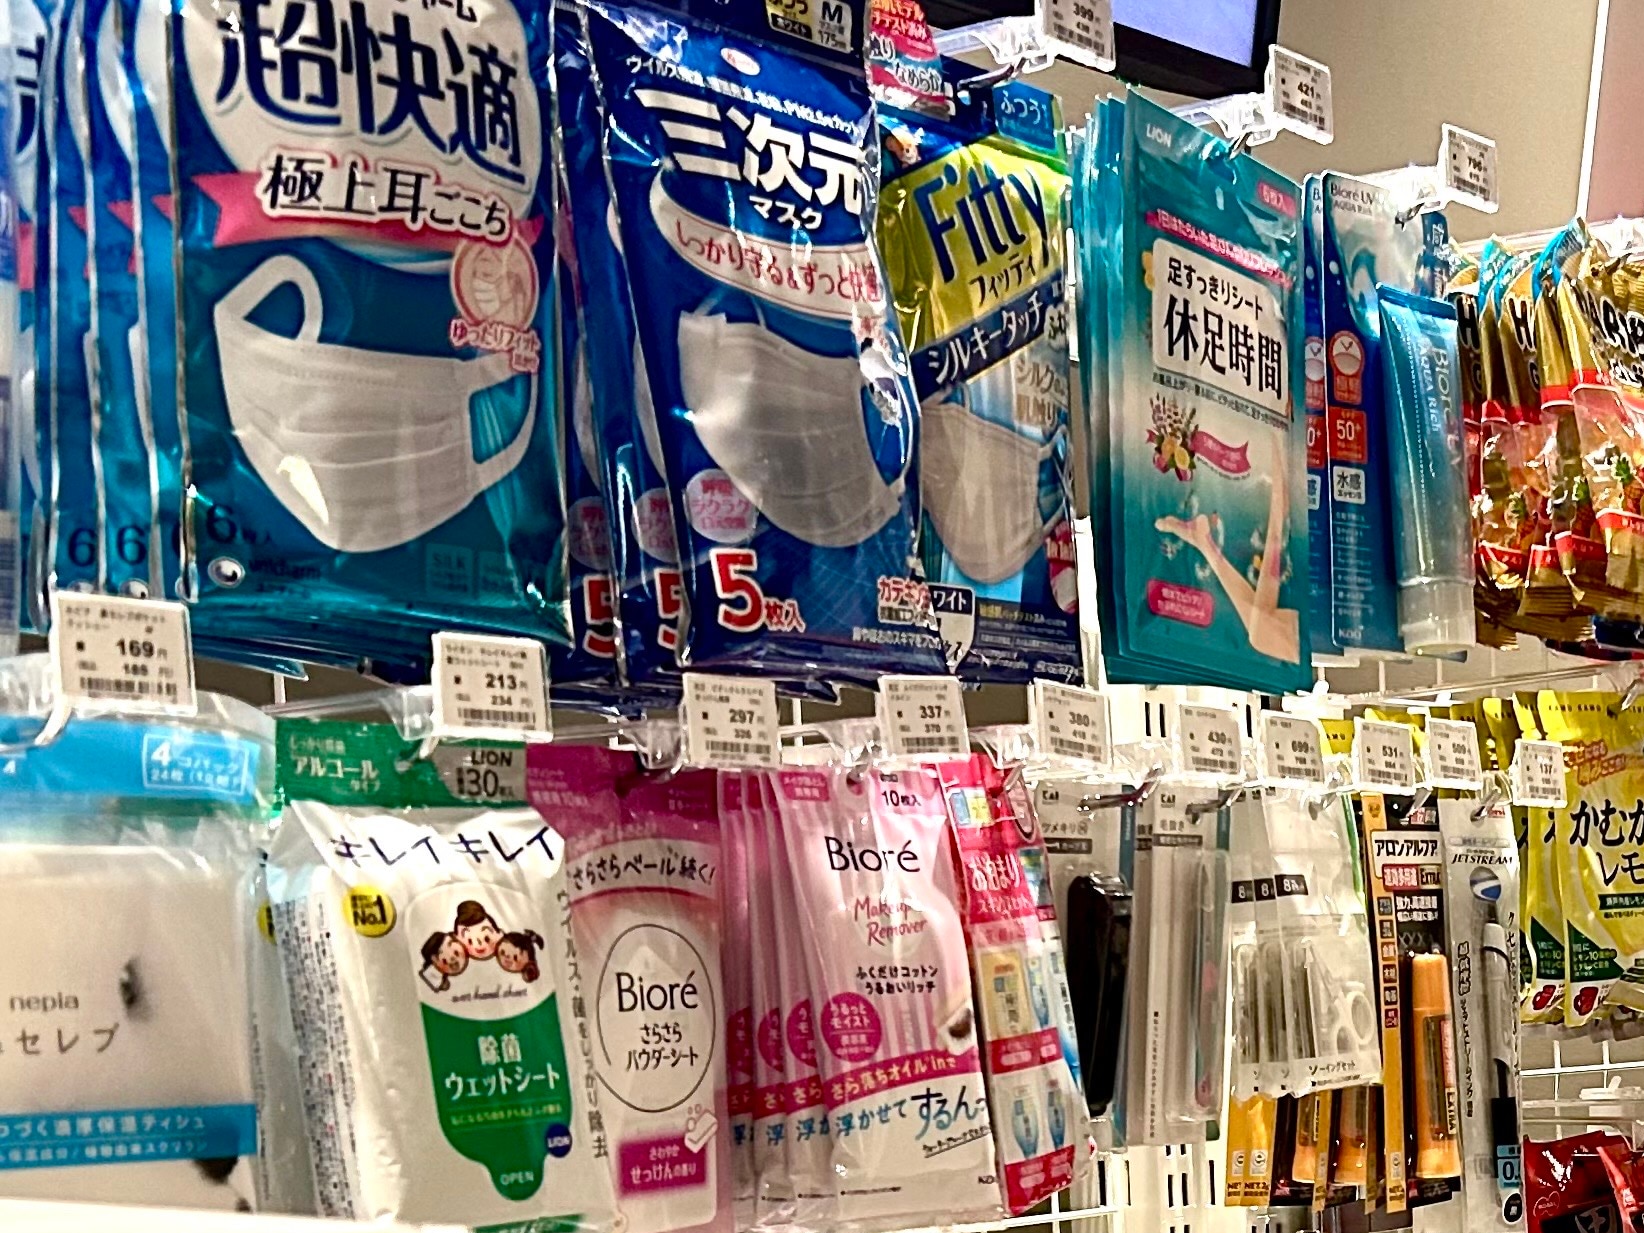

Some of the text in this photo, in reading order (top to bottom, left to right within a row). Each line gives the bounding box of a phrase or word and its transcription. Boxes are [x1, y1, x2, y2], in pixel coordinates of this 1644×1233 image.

[821, 1, 842, 24] M
[216, 0, 526, 185] 超快適
[1146, 124, 1172, 148] LION
[634, 89, 864, 215] 三次元
[264, 154, 507, 236] 極上耳ごこち
[1330, 182, 1359, 202] Bioré
[749, 195, 822, 230] マスク
[912, 162, 1051, 284] Fitty
[969, 254, 1033, 307] フィッティ
[1167, 257, 1263, 321] 足すっきりシート
[929, 291, 1043, 384] シルキータッチ
[1163, 294, 1284, 400] 休足時間
[68, 528, 97, 568] 6
[117, 525, 146, 566] 6
[710, 549, 807, 632] 5枚入
[116, 638, 154, 658] 169
[485, 675, 517, 690] 213
[729, 709, 756, 724] 297
[919, 704, 944, 720] 337
[295, 757, 378, 780] アルコール
[471, 750, 512, 768] LION
[881, 790, 922, 809] 10枚入
[330, 826, 554, 869] キレイキレイ
[825, 836, 920, 873] Bioré
[1452, 853, 1513, 866] JETSTREAM
[867, 918, 927, 947] Remover
[856, 964, 938, 981] ふくだけコットン
[616, 963, 699, 1013] Bioré
[865, 980, 936, 995] うるおいリッチ
[10, 991, 79, 1014] nepia
[829, 1003, 867, 1018] うるっと
[639, 1021, 683, 1046] さらさら
[829, 1017, 870, 1031] モイスト
[0, 1023, 119, 1056] セレブ
[478, 1033, 522, 1066] 除菌
[626, 1047, 699, 1072] パウダーシート
[445, 1064, 561, 1101] ウェットシート
[836, 1098, 907, 1137] 浮かせて
[650, 1144, 679, 1160] さわやか
[500, 1172, 534, 1186] OPEN
